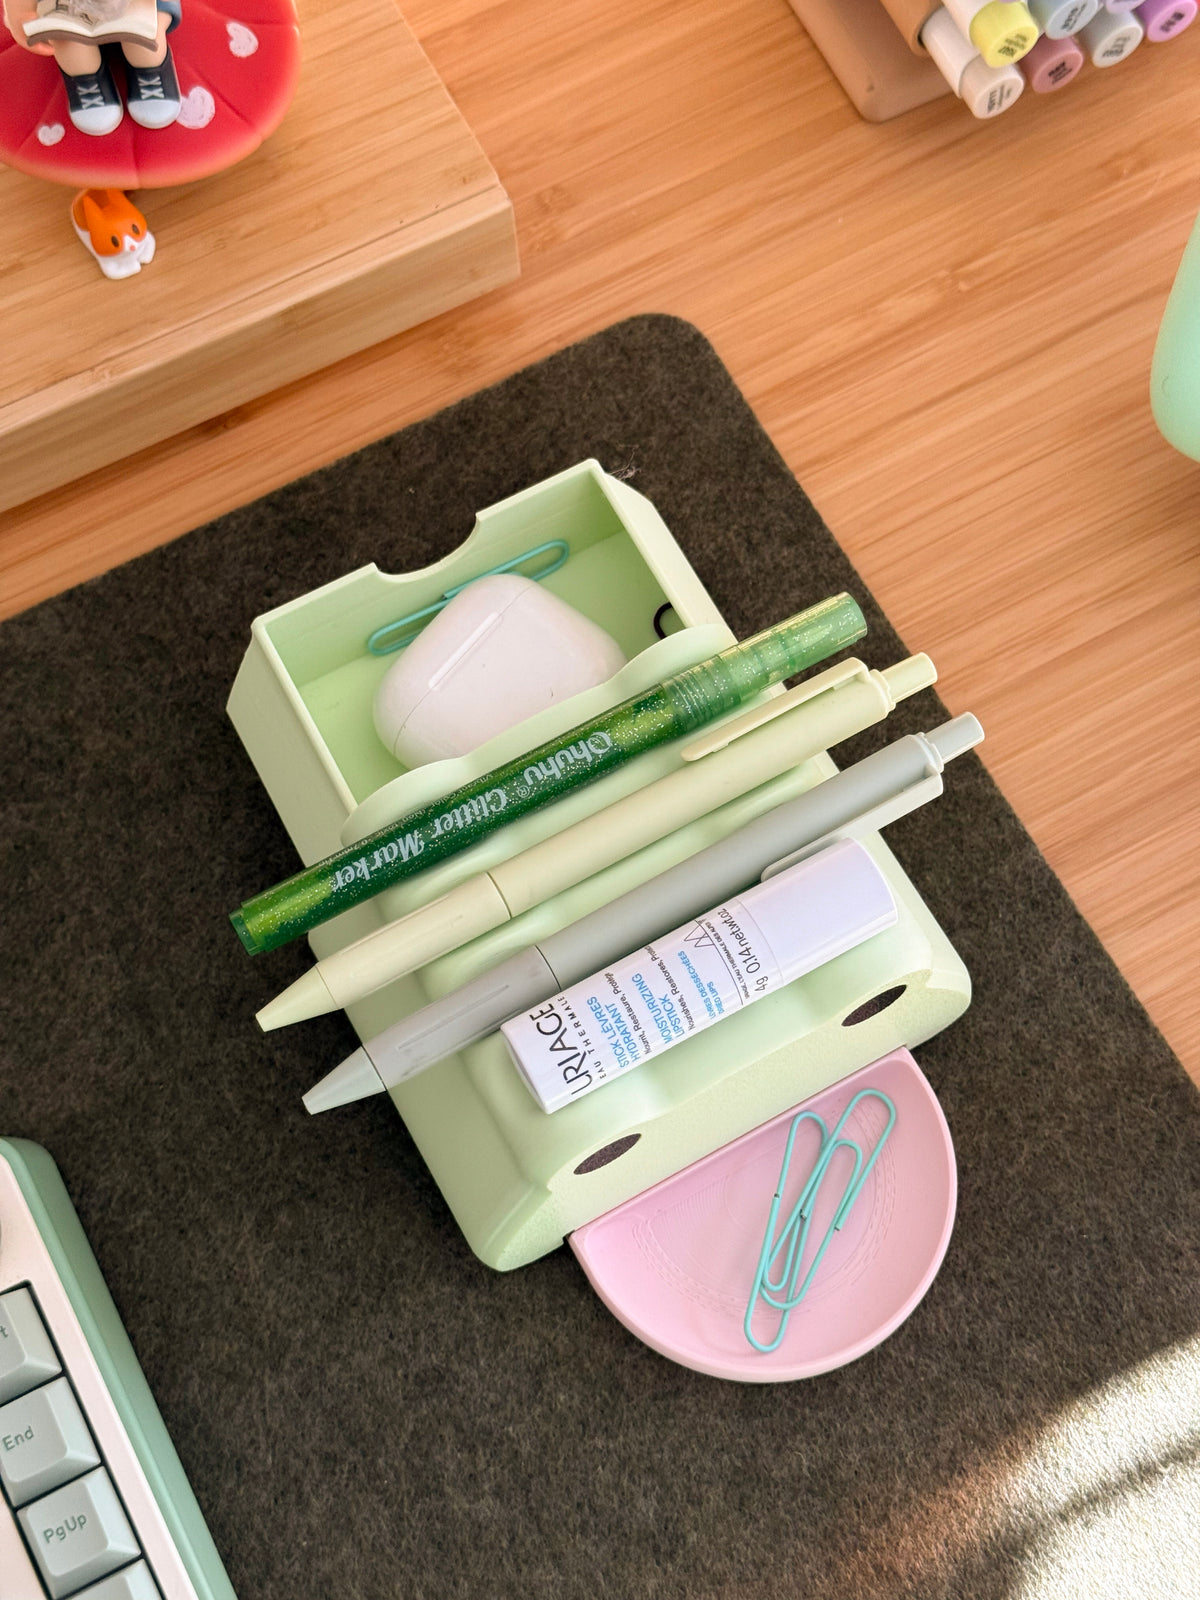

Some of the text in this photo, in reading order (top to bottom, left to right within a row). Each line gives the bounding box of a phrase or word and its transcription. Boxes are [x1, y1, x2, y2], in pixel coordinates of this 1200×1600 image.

[331, 731, 613, 893] Ohuhu Glitter Marker
[657, 959, 680, 996] Restores,
[754, 975, 769, 992] 4g
[619, 993, 642, 1032] Restaure,
[631, 972, 673, 1044] MOISTURIZING
[658, 993, 685, 1038] LIPSTICK
[677, 994, 696, 1031] Nourishes,
[528, 1002, 593, 1095] URIAGE
[557, 996, 607, 1080] EAU THERMALE
[604, 1003, 641, 1062] HYDRATANT
[609, 1038, 630, 1068] STICK
[1, 1425, 35, 1452] End
[43, 1513, 87, 1544] PgUp
